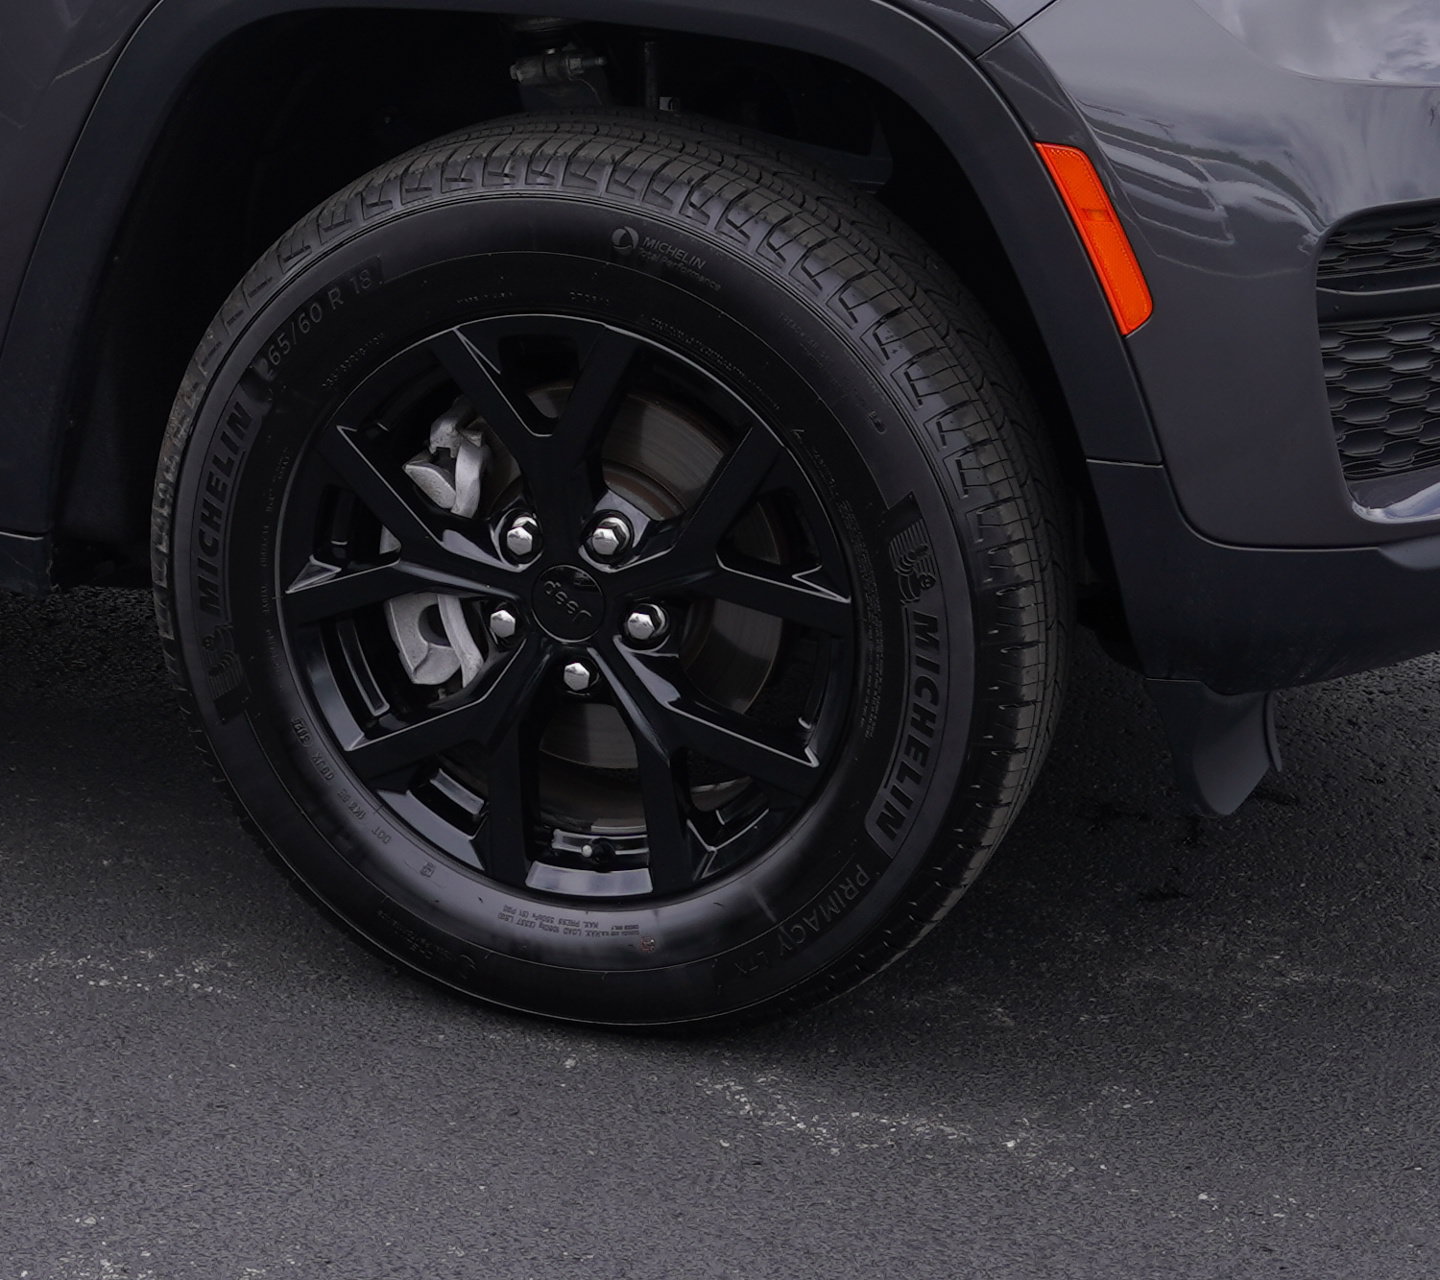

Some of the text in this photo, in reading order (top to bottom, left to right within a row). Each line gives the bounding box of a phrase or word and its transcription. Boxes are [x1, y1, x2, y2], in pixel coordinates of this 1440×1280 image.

[642, 236, 706, 270] MICHELIN
[200, 401, 255, 616] MICHELIN
[877, 610, 941, 842] MICHELIN
[777, 864, 870, 956] PRIMACY
